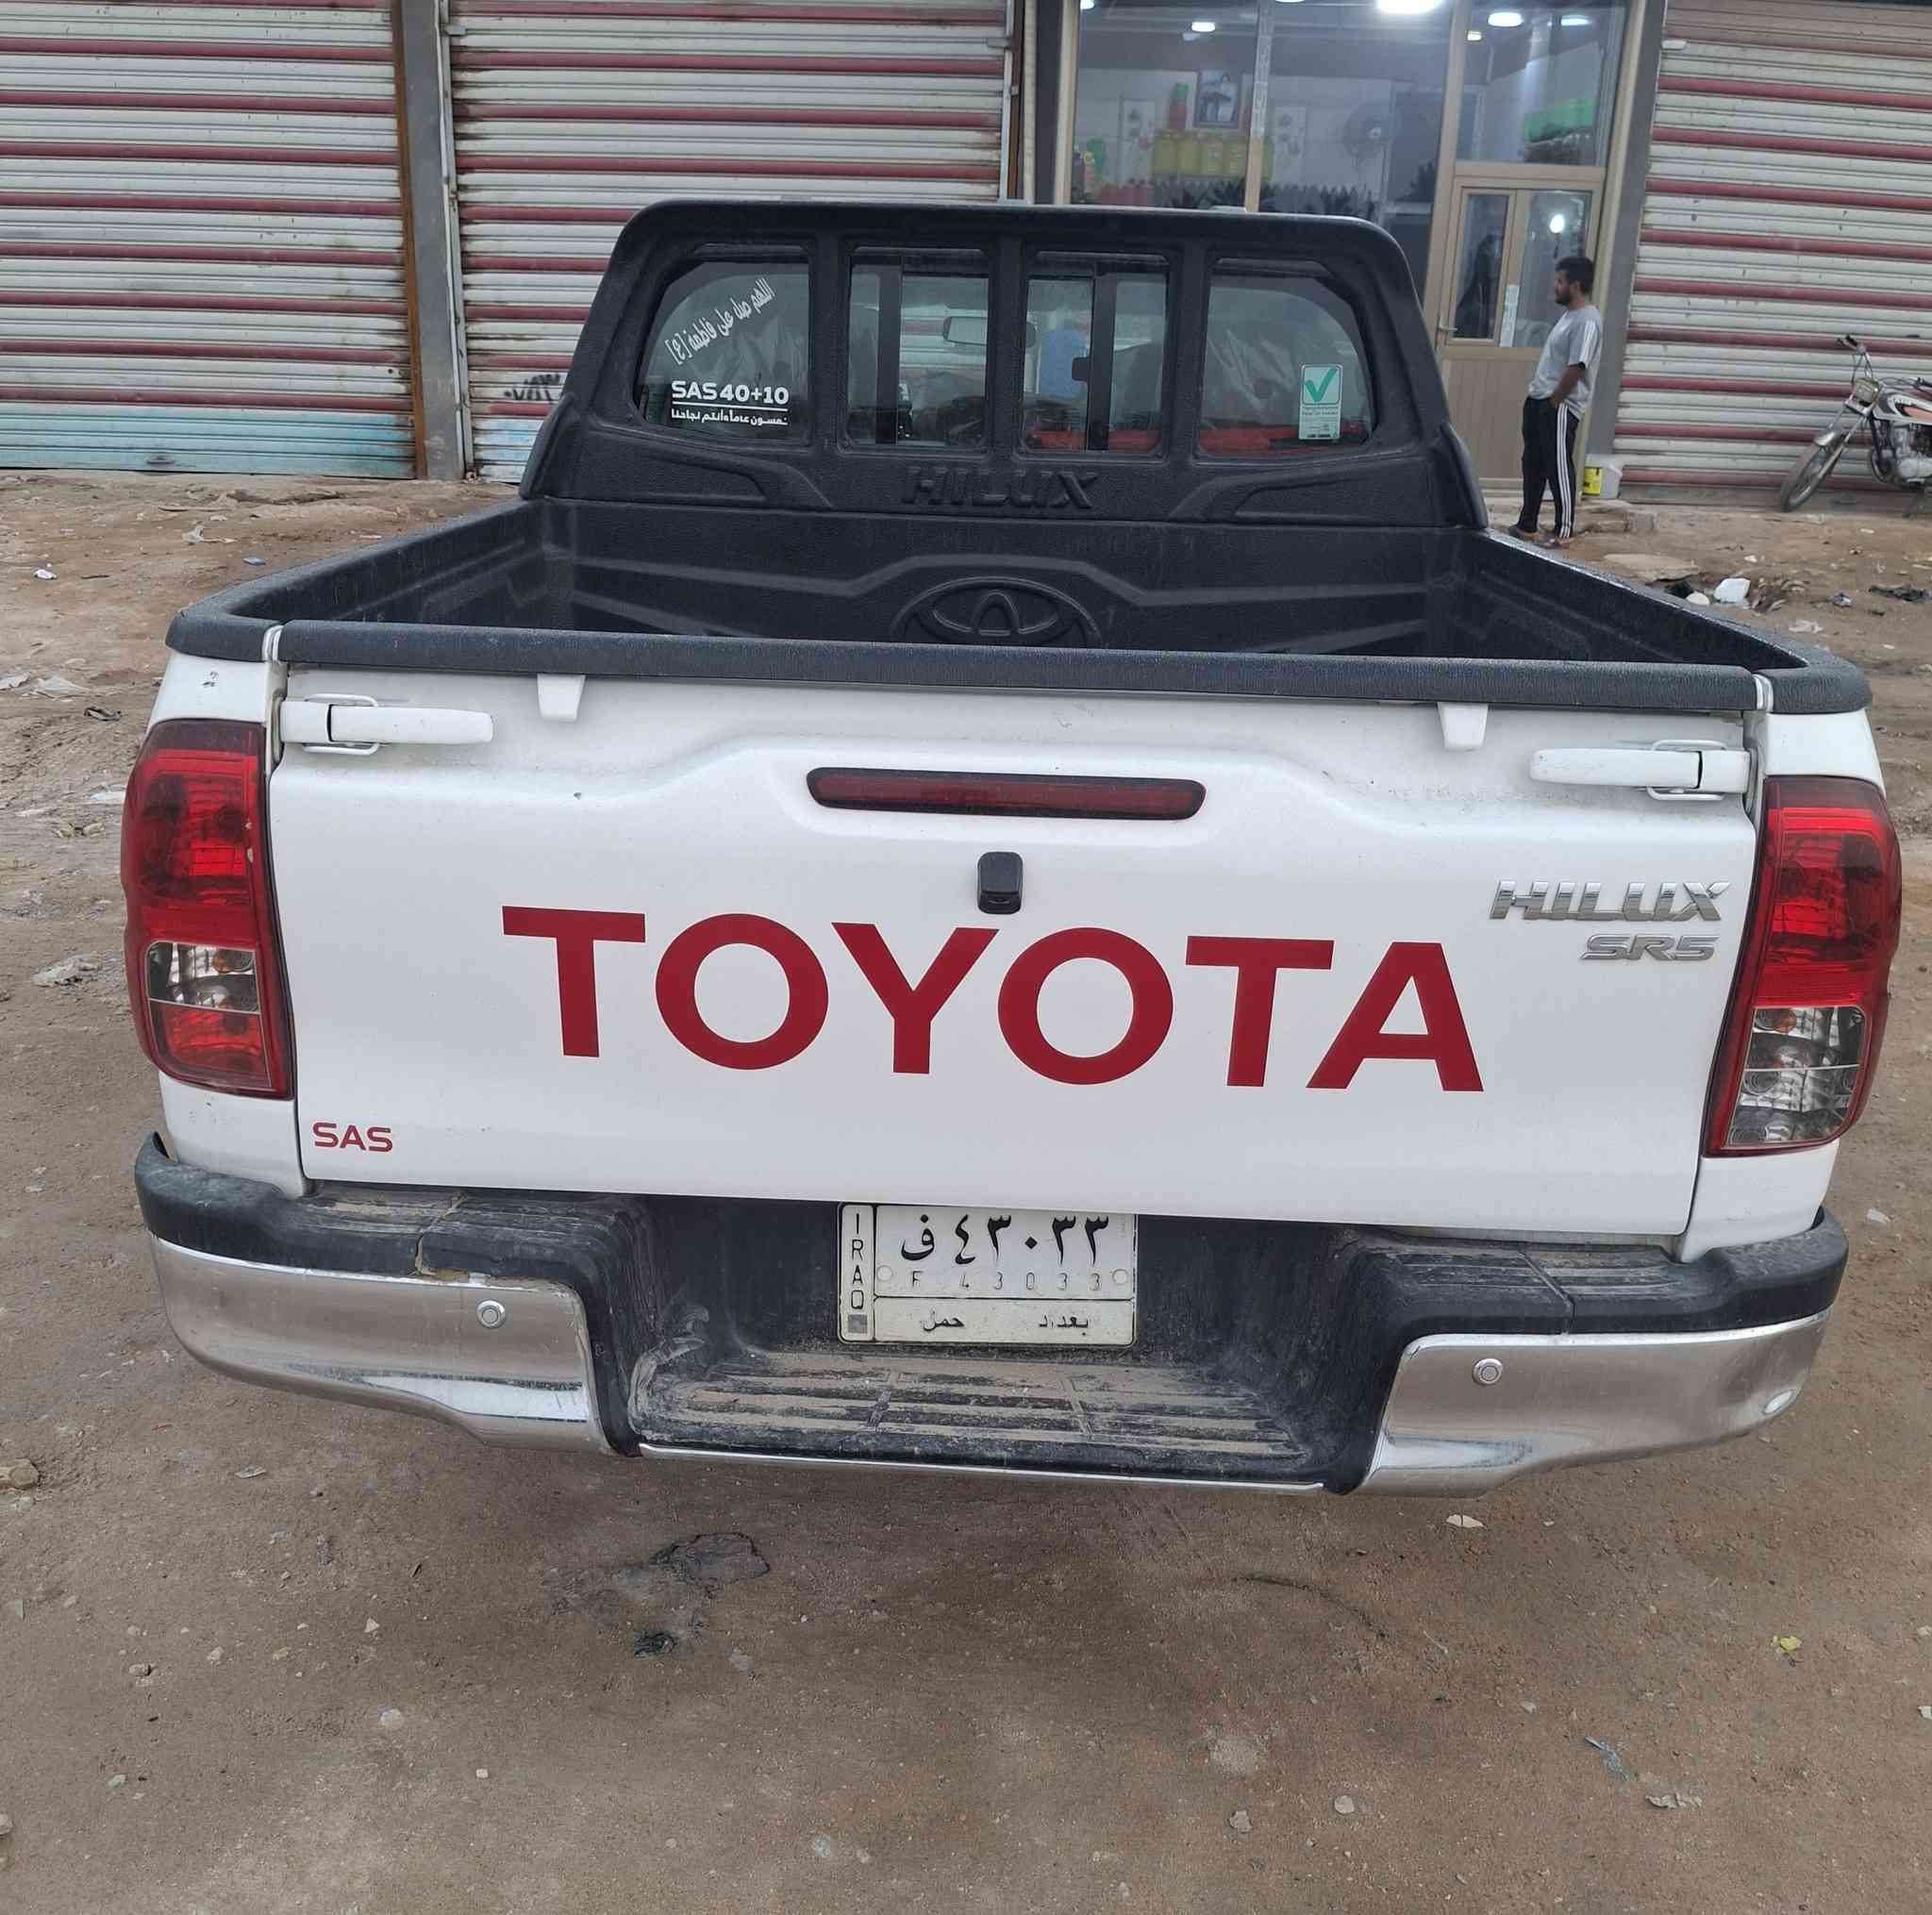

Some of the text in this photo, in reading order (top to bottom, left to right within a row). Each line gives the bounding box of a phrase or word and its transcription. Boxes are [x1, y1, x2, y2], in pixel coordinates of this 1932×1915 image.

[730, 297, 753, 320] صل
[751, 277, 775, 314] اللهم
[715, 308, 734, 337] على
[671, 380, 790, 405] SAS 40+10
[902, 466, 1097, 509] HILUX
[1490, 879, 1730, 922] HILUX
[503, 906, 1483, 1091] TOYOTA
[312, 1122, 393, 1152] SAS
[851, 1213, 864, 1309] IRAQ
